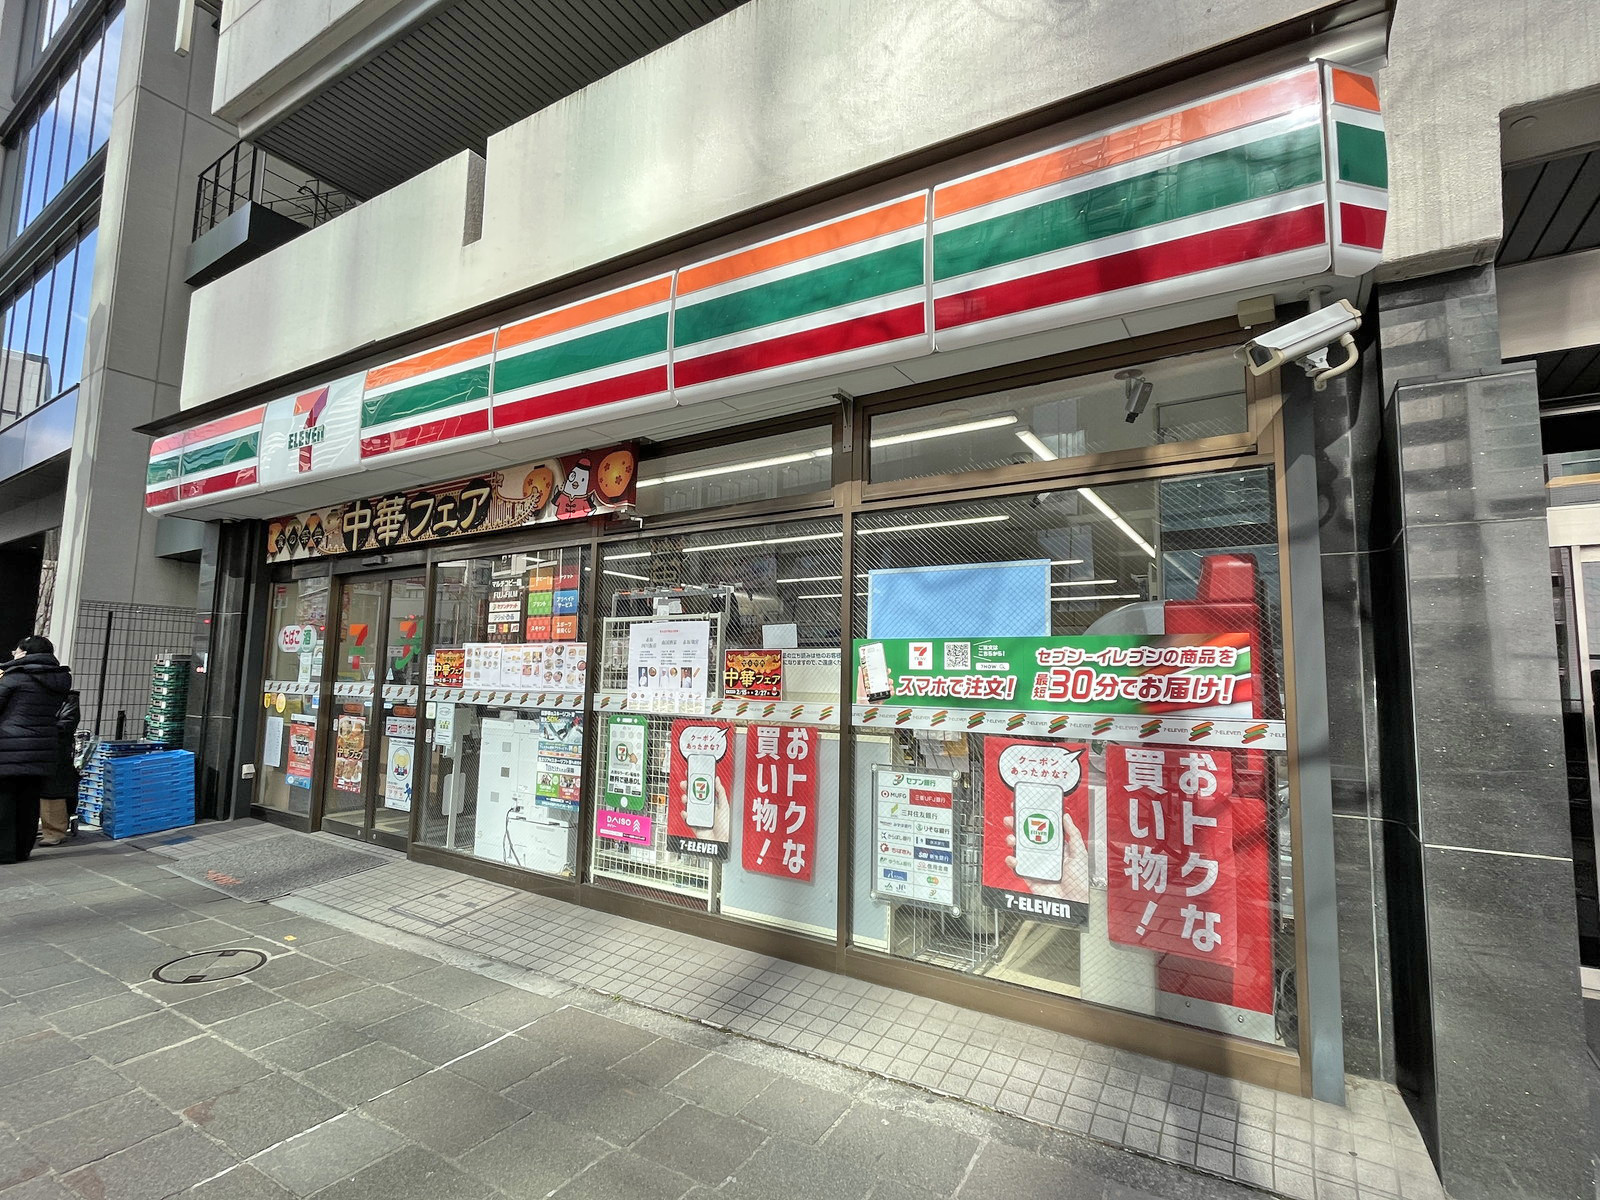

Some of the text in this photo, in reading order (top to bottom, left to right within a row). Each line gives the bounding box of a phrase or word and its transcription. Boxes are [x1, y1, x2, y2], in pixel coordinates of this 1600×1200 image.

[343, 487, 490, 550] 中華フェア
[724, 667, 781, 688] 中華フェア
[897, 676, 1016, 699] スマホで注文!
[690, 734, 715, 742] クーポン
[1018, 755, 1060, 767] クーポン
[752, 726, 781, 865] 買い物!
[783, 727, 809, 875] おトクな
[607, 815, 631, 826] DAISO
[901, 809, 938, 820] 三井住友銀行
[1123, 748, 1168, 937] 買い物!
[1178, 752, 1222, 952] おトクな
